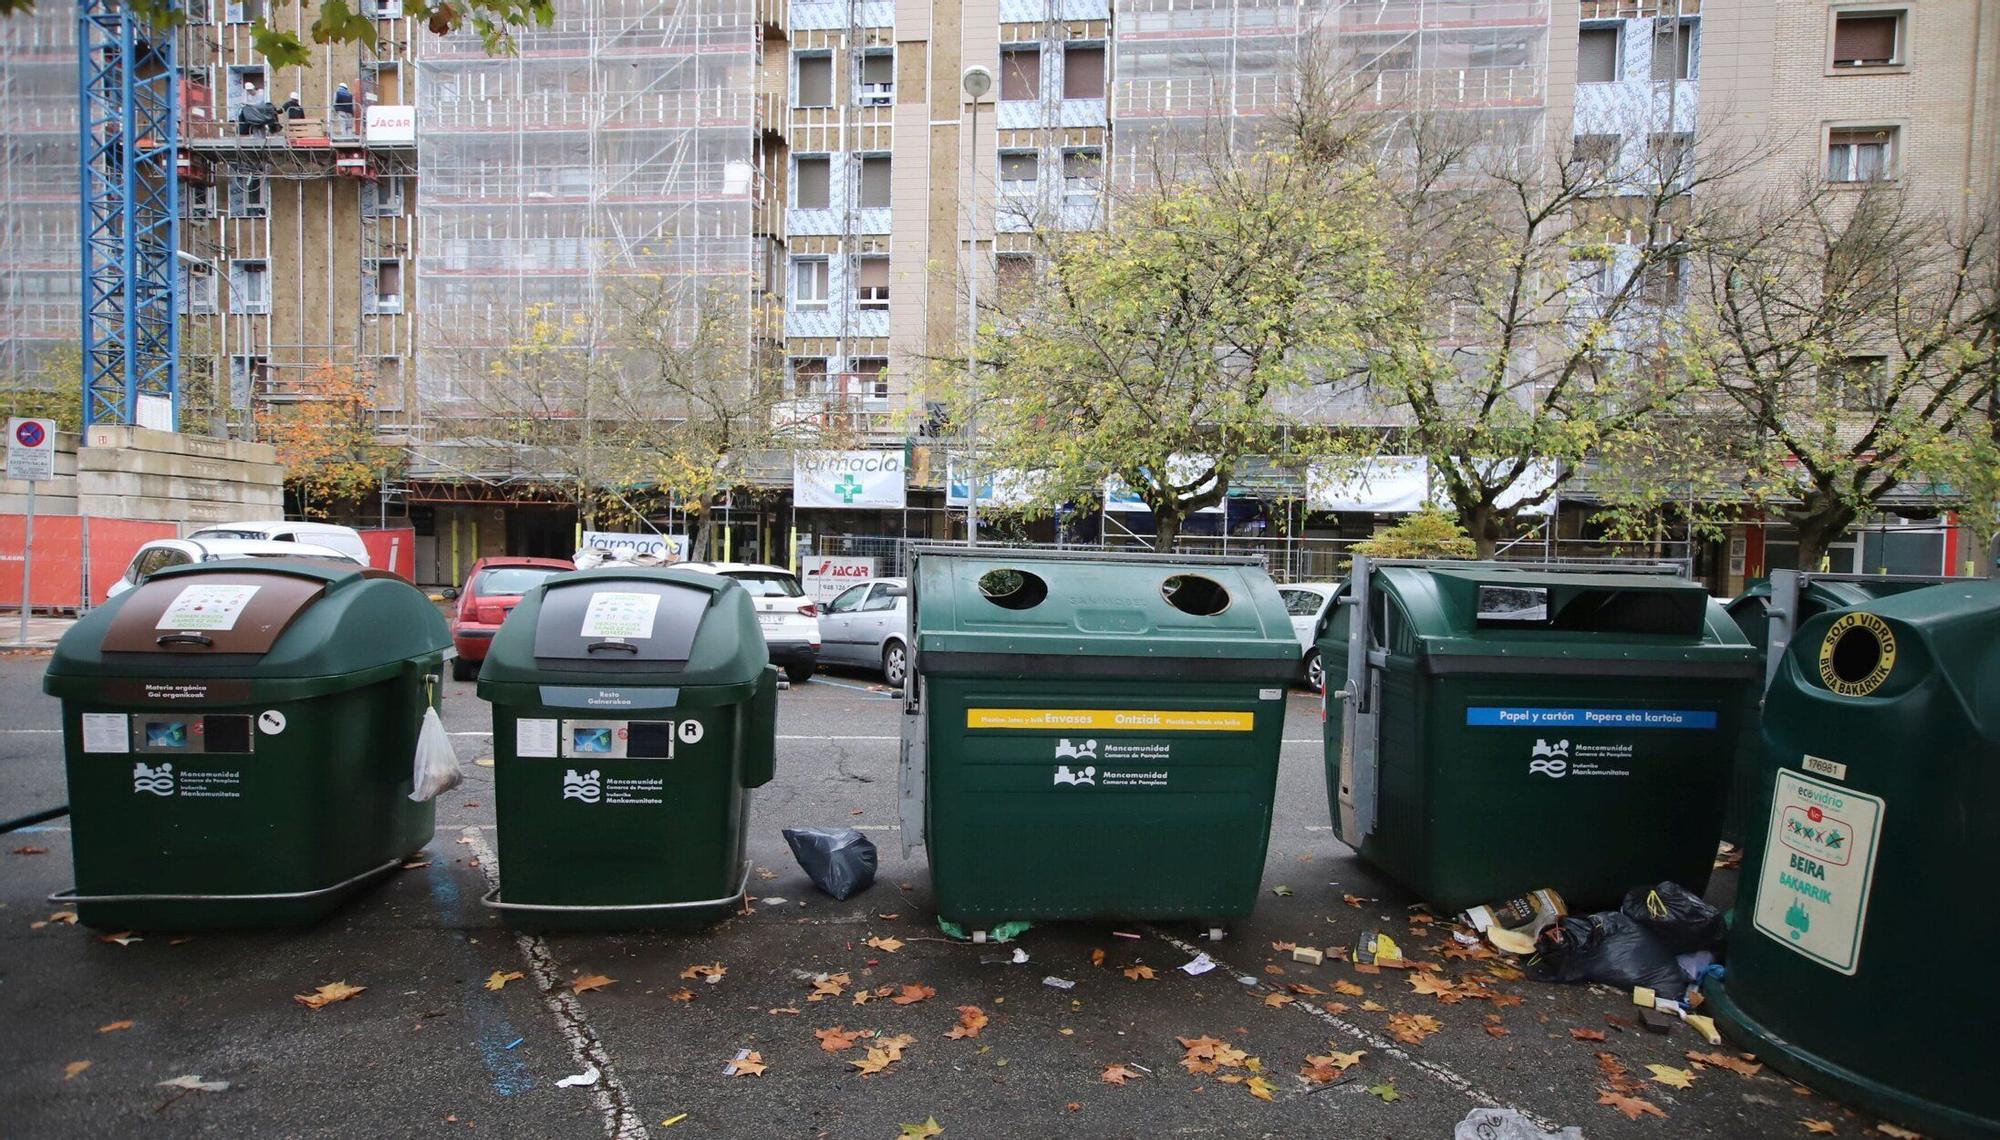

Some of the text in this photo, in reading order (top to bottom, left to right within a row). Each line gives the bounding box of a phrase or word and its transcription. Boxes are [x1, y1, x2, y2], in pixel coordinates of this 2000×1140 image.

[1826, 614, 1894, 654] SOLO VIDRIO
[1820, 657, 1890, 696] BEIRA BAKARRIK
[175, 684, 207, 692] orgánica
[162, 691, 205, 699] organikoak
[1045, 713, 1093, 724] Envases
[1115, 714, 1161, 725] Ontziak
[1500, 711, 1575, 722] Papel y cartón
[1585, 712, 1683, 723] Papera eta kartoia
[684, 723, 697, 736] R
[1104, 744, 1170, 752] Mancomunidad
[1575, 743, 1633, 752] Mancomunidad
[1808, 758, 1838, 775] 176981
[1102, 771, 1168, 779] Mancomunidad
[1138, 779, 1168, 787] Pamplona
[1797, 786, 1843, 809] ecovidrio
[1789, 853, 1825, 881] BEIRA
[1779, 871, 1832, 904] BAKARRIK
